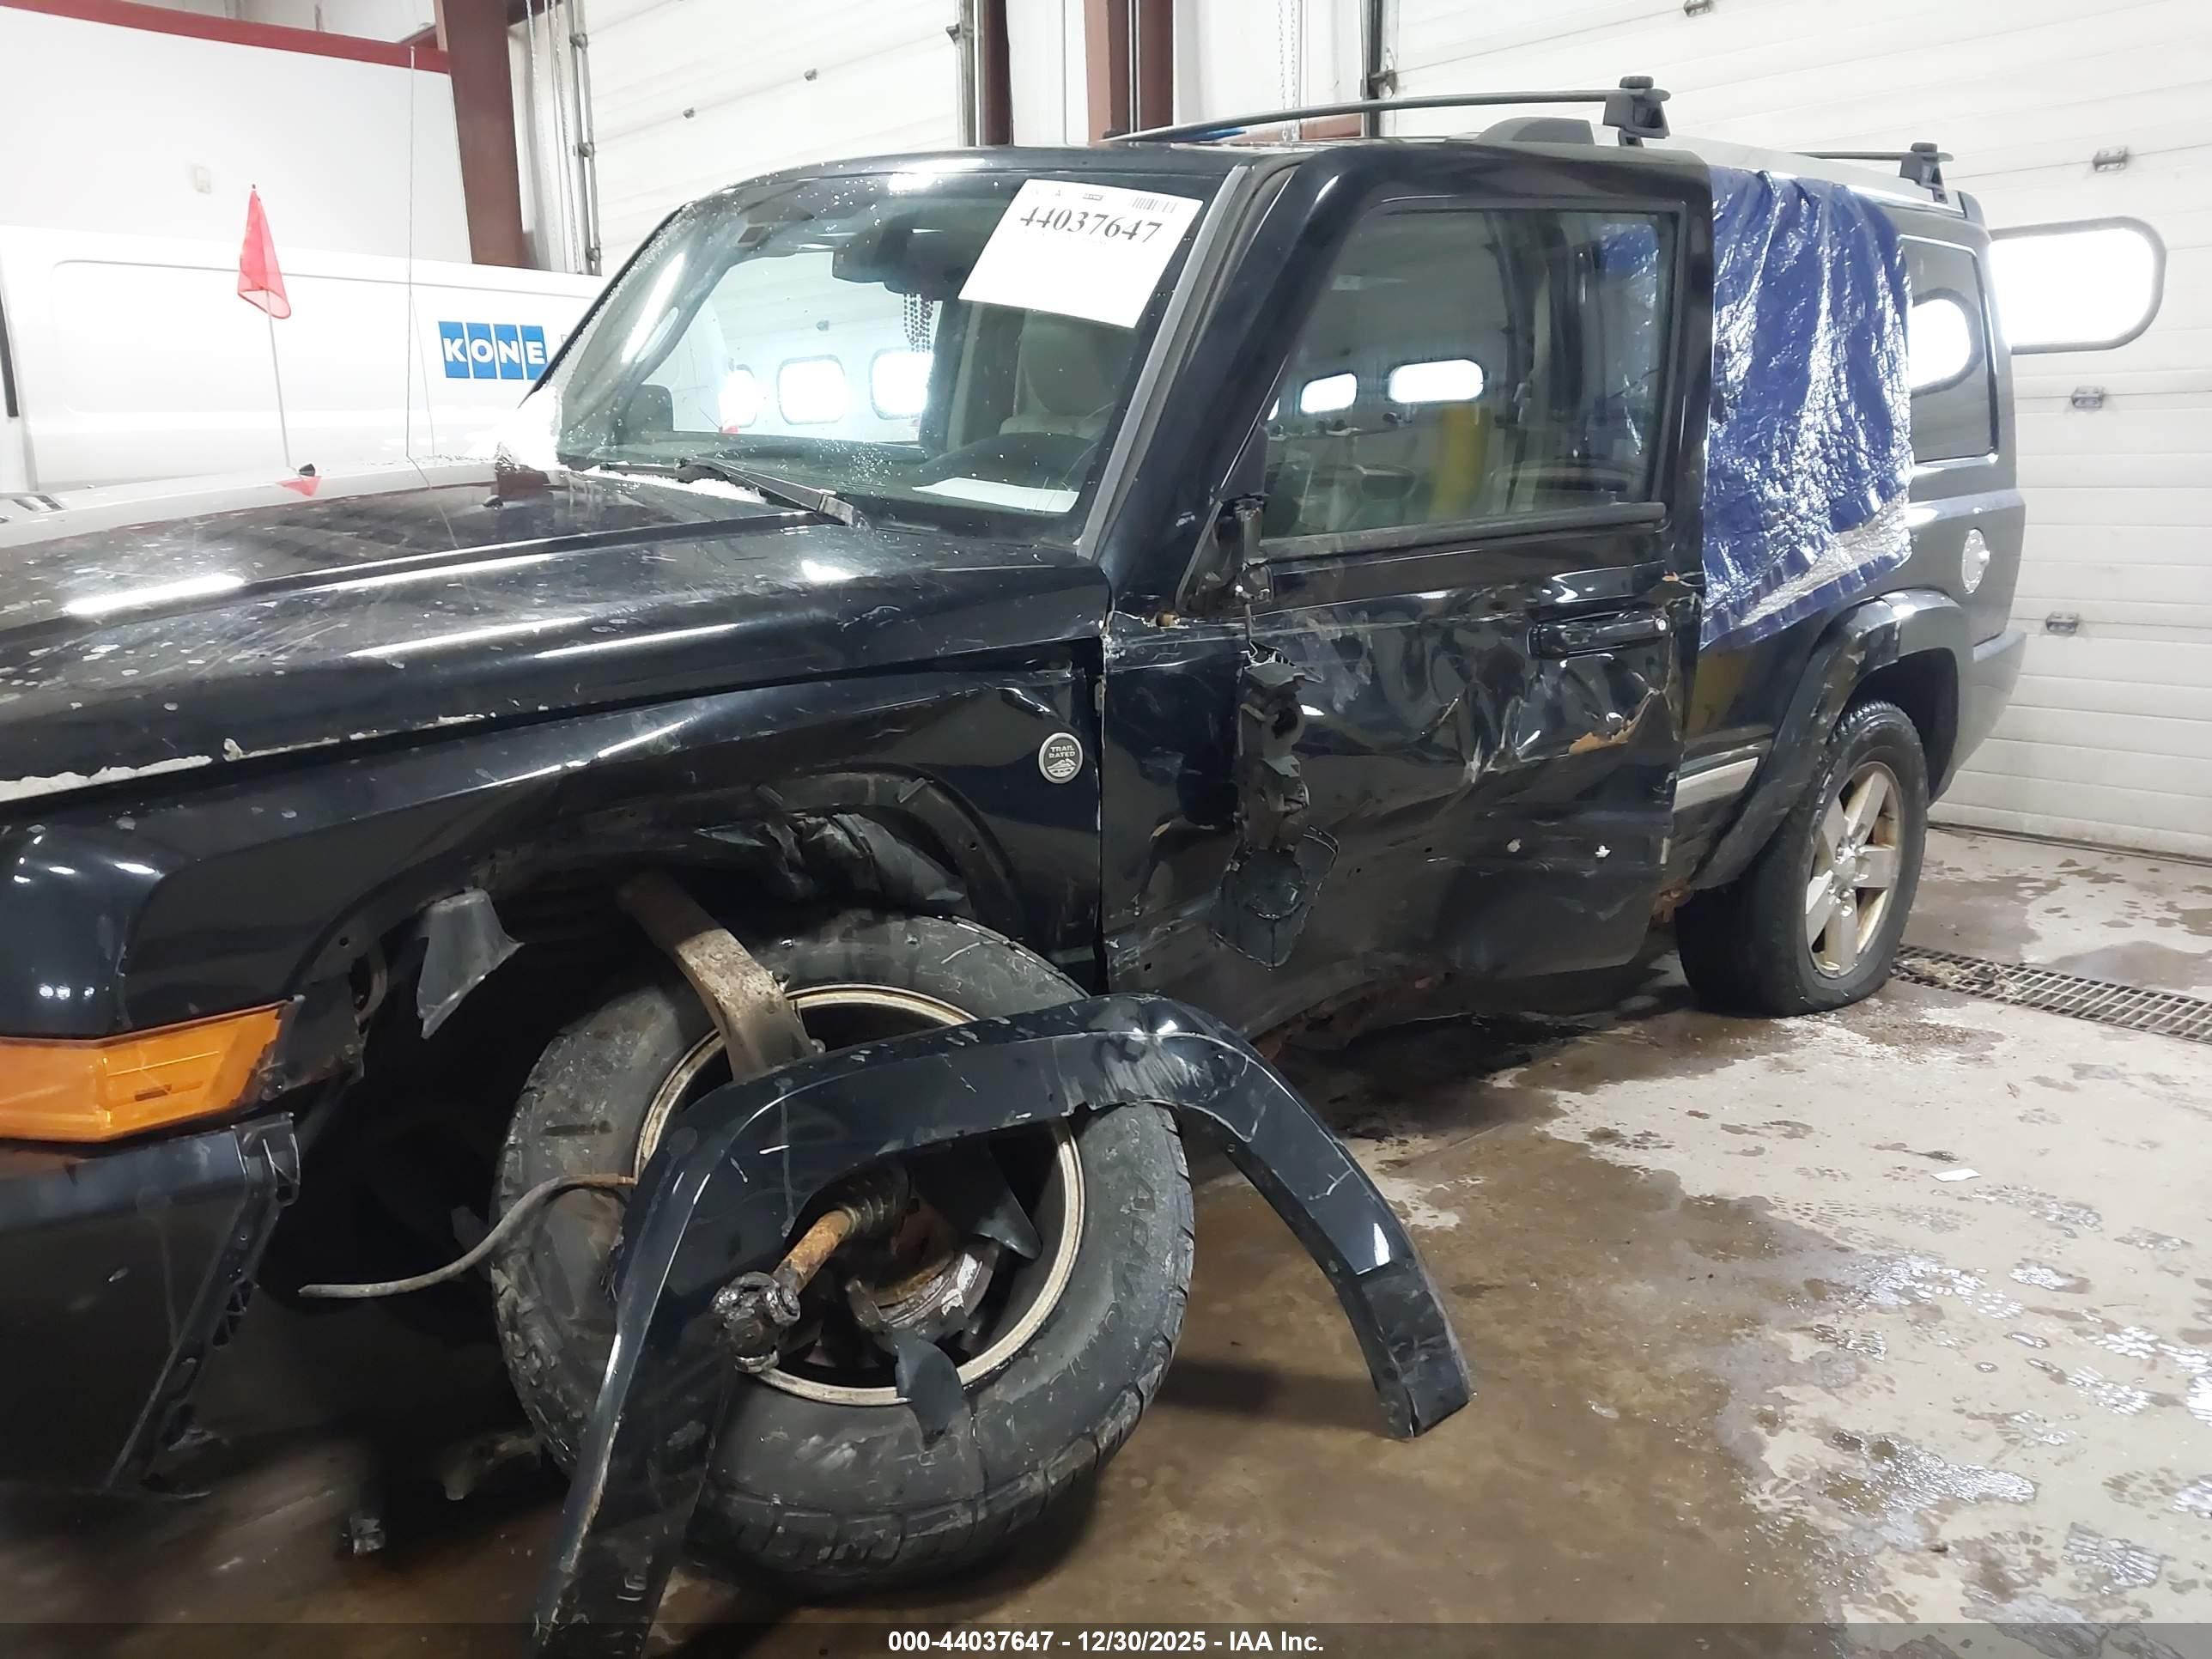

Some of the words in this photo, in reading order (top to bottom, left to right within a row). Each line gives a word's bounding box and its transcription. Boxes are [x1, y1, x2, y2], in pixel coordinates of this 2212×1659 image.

[1020, 206, 1163, 243] 44037647
[442, 337, 546, 364] KONE
[1048, 750, 1076, 759] RATED
[1050, 744, 1076, 753] TRAIL
